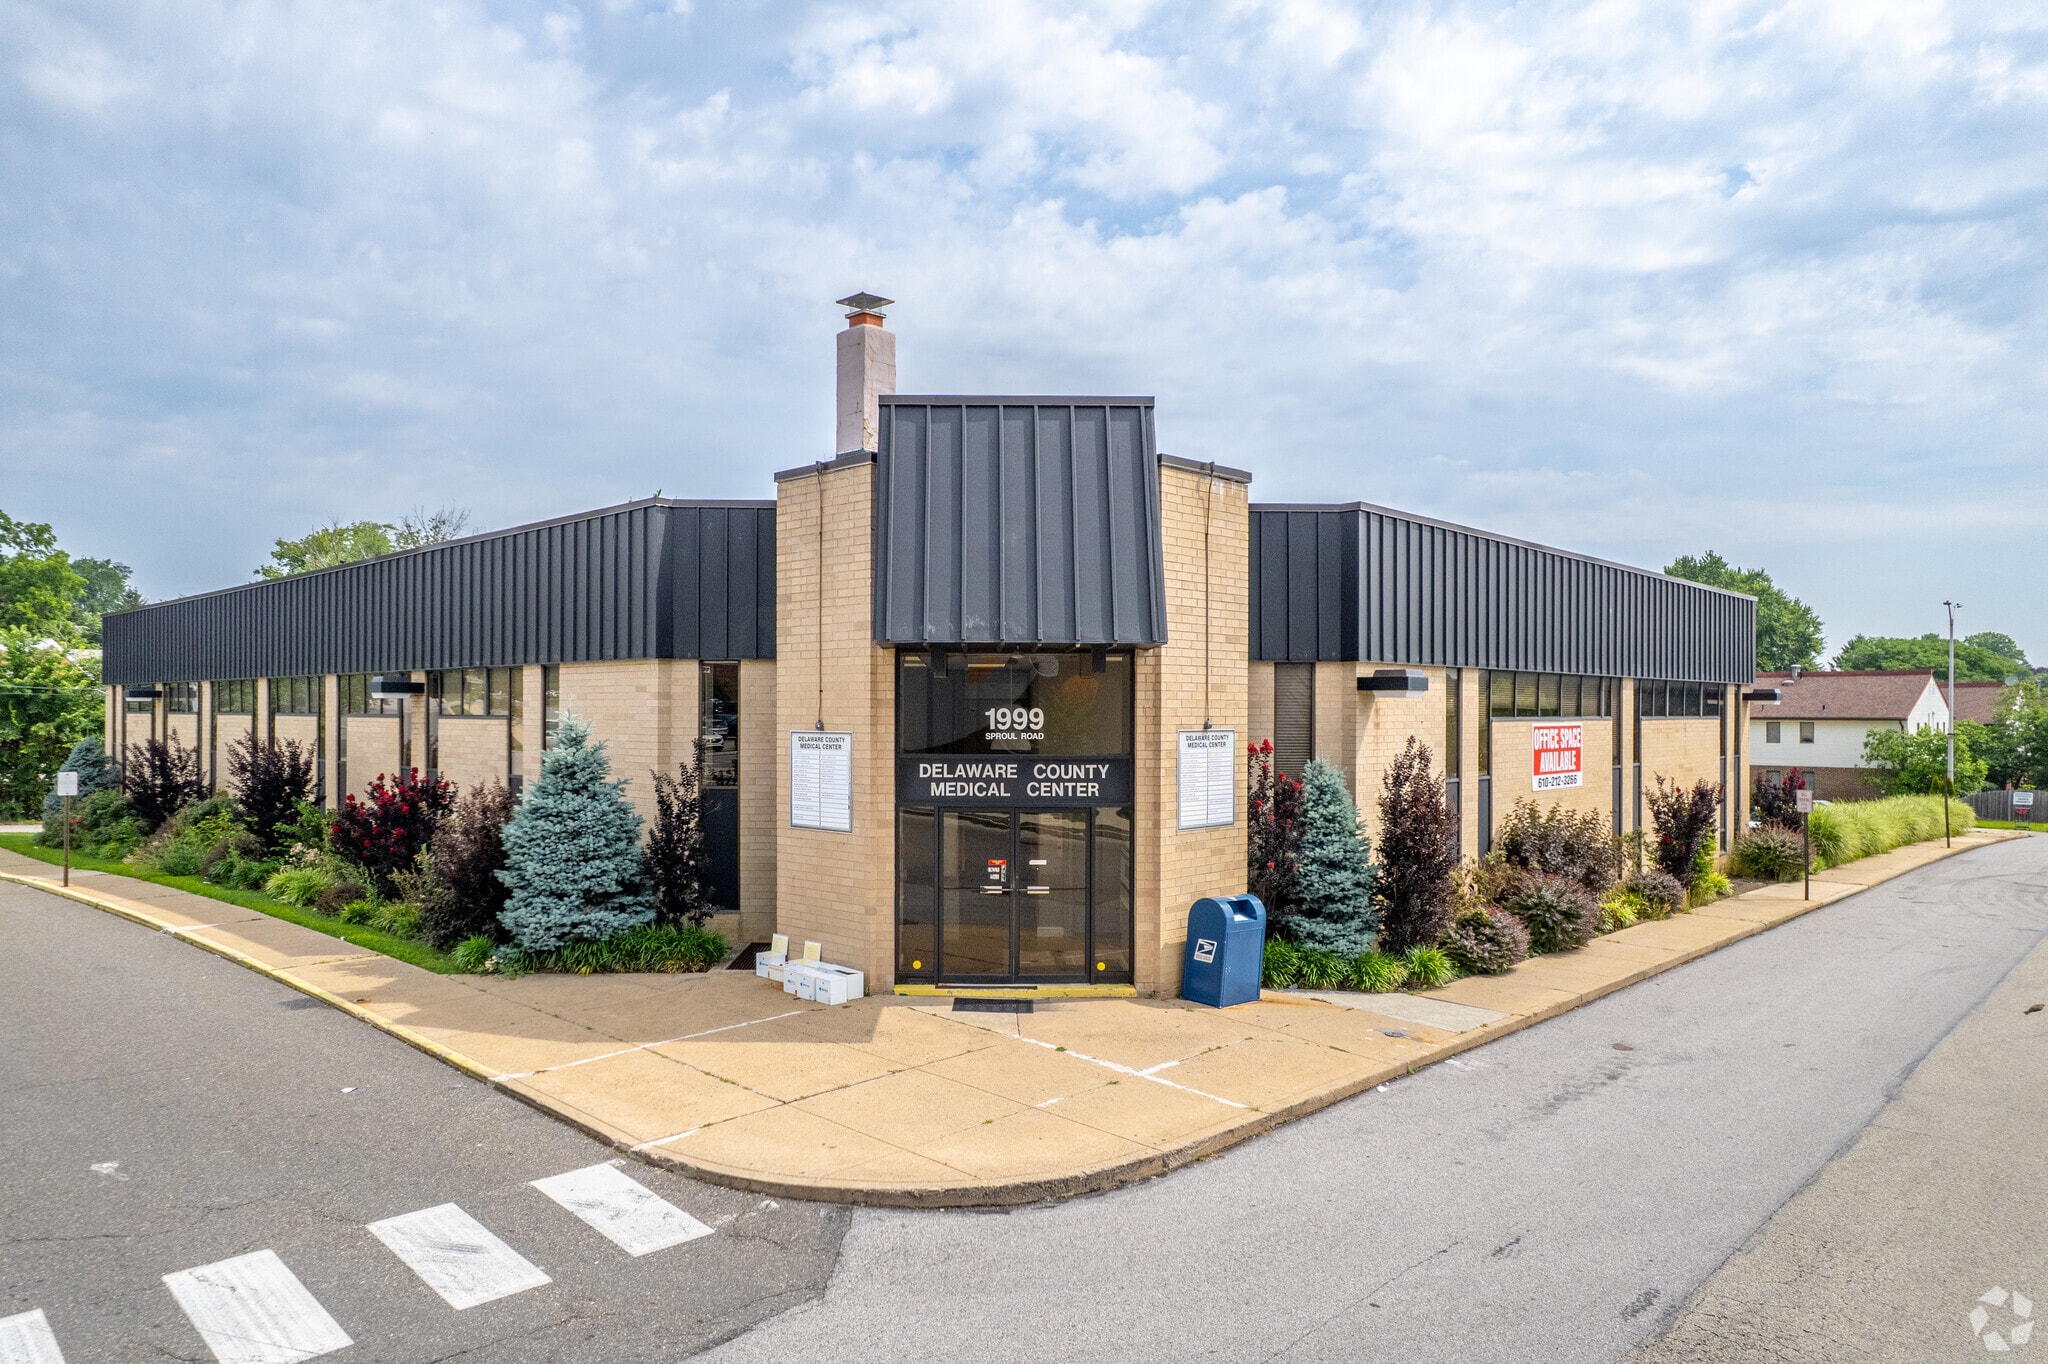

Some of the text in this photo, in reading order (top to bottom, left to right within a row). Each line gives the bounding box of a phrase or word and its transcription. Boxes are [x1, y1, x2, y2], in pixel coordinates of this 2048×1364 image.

[985, 707, 1044, 730] 1999
[985, 732, 1044, 740] SPROUL ROAD
[1534, 728, 1581, 750] OFFICE SPACE
[1540, 751, 1576, 772] AVAILABLE
[919, 763, 1110, 780] DELAWARE COUNTY
[930, 781, 1100, 797] MEDICAL CENTER
[1538, 775, 1577, 788] 610-212-3266
